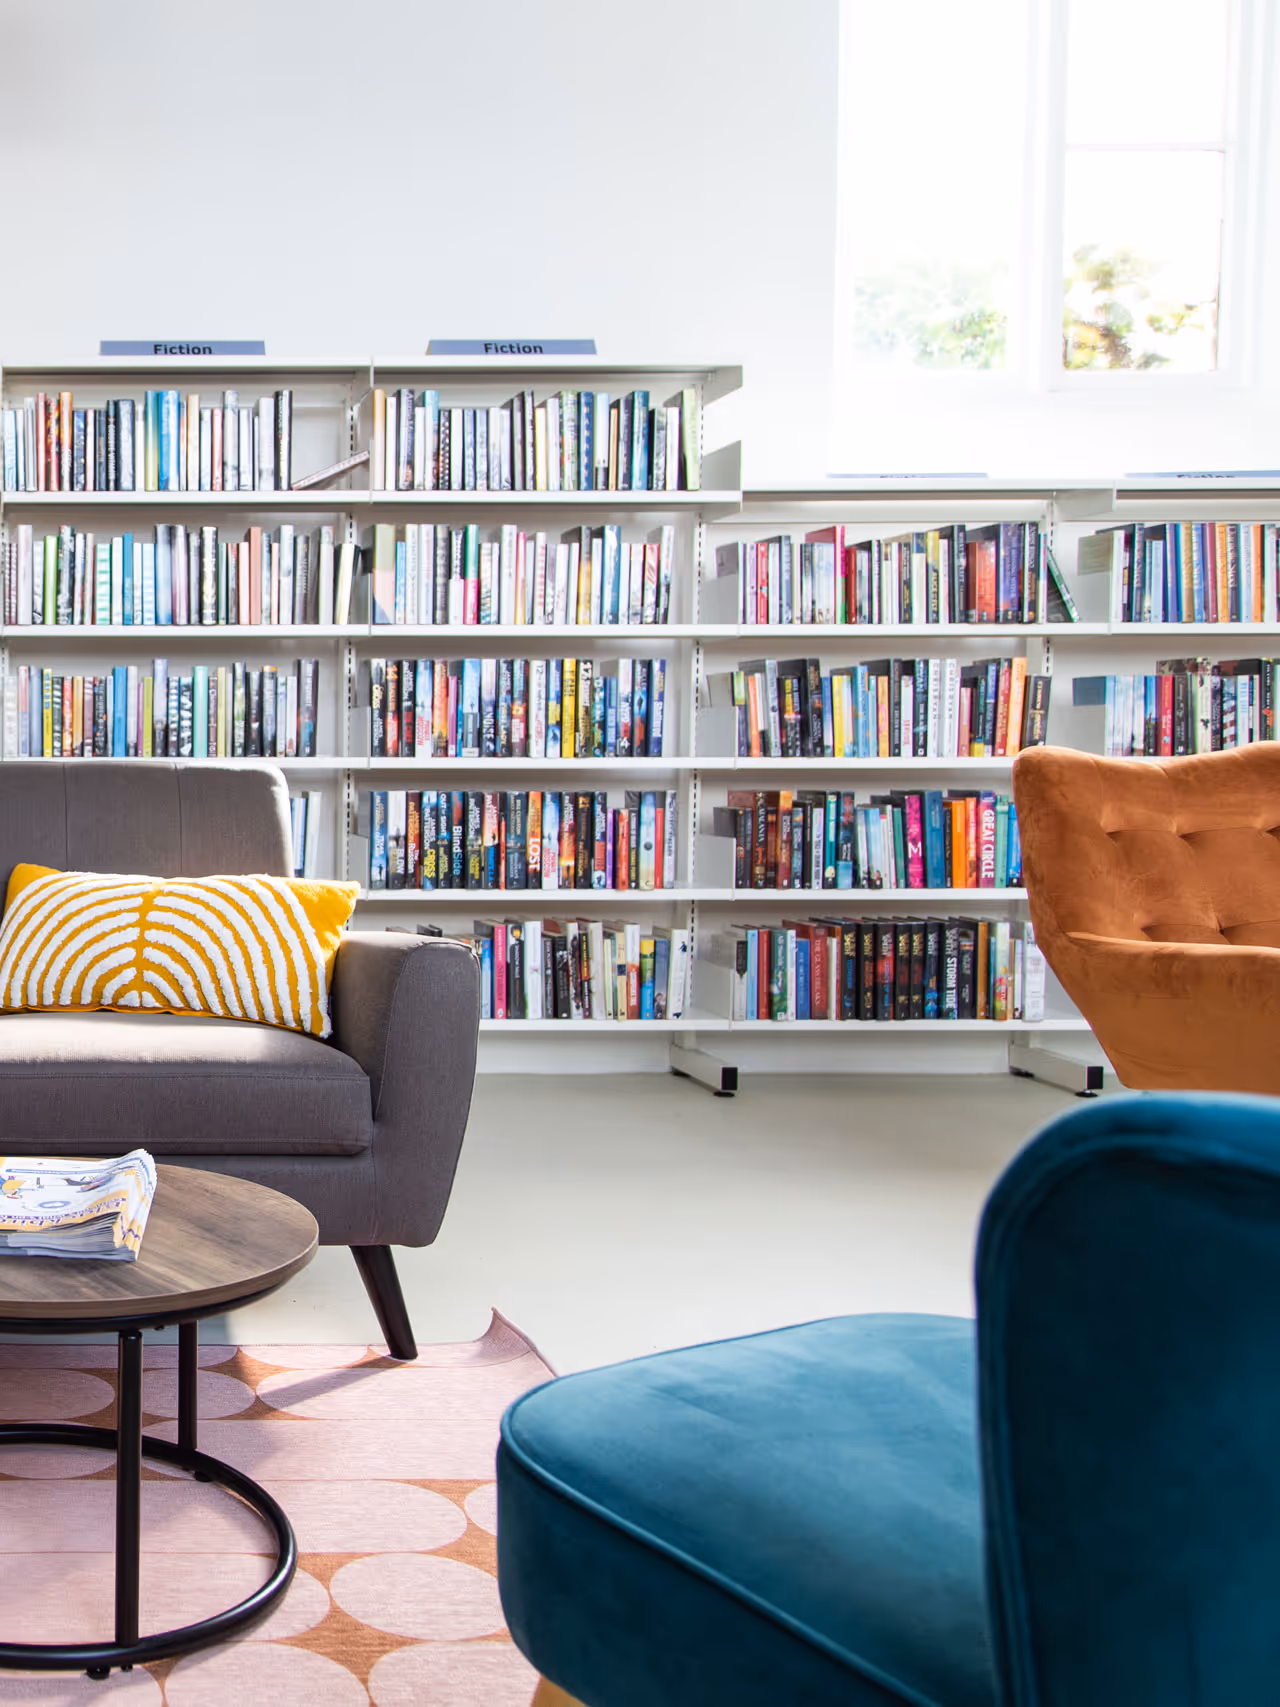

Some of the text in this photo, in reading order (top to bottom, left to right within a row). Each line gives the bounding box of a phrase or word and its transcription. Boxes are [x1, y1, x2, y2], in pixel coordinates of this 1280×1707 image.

[153, 344, 213, 355] Fiction
[484, 343, 544, 354] Fiction
[453, 826, 462, 875] BlindSide
[529, 838, 540, 870] LOST
[982, 810, 994, 878] GREAT CIRCLE
[947, 958, 956, 987] STORM
[946, 990, 955, 1008] TIDE
